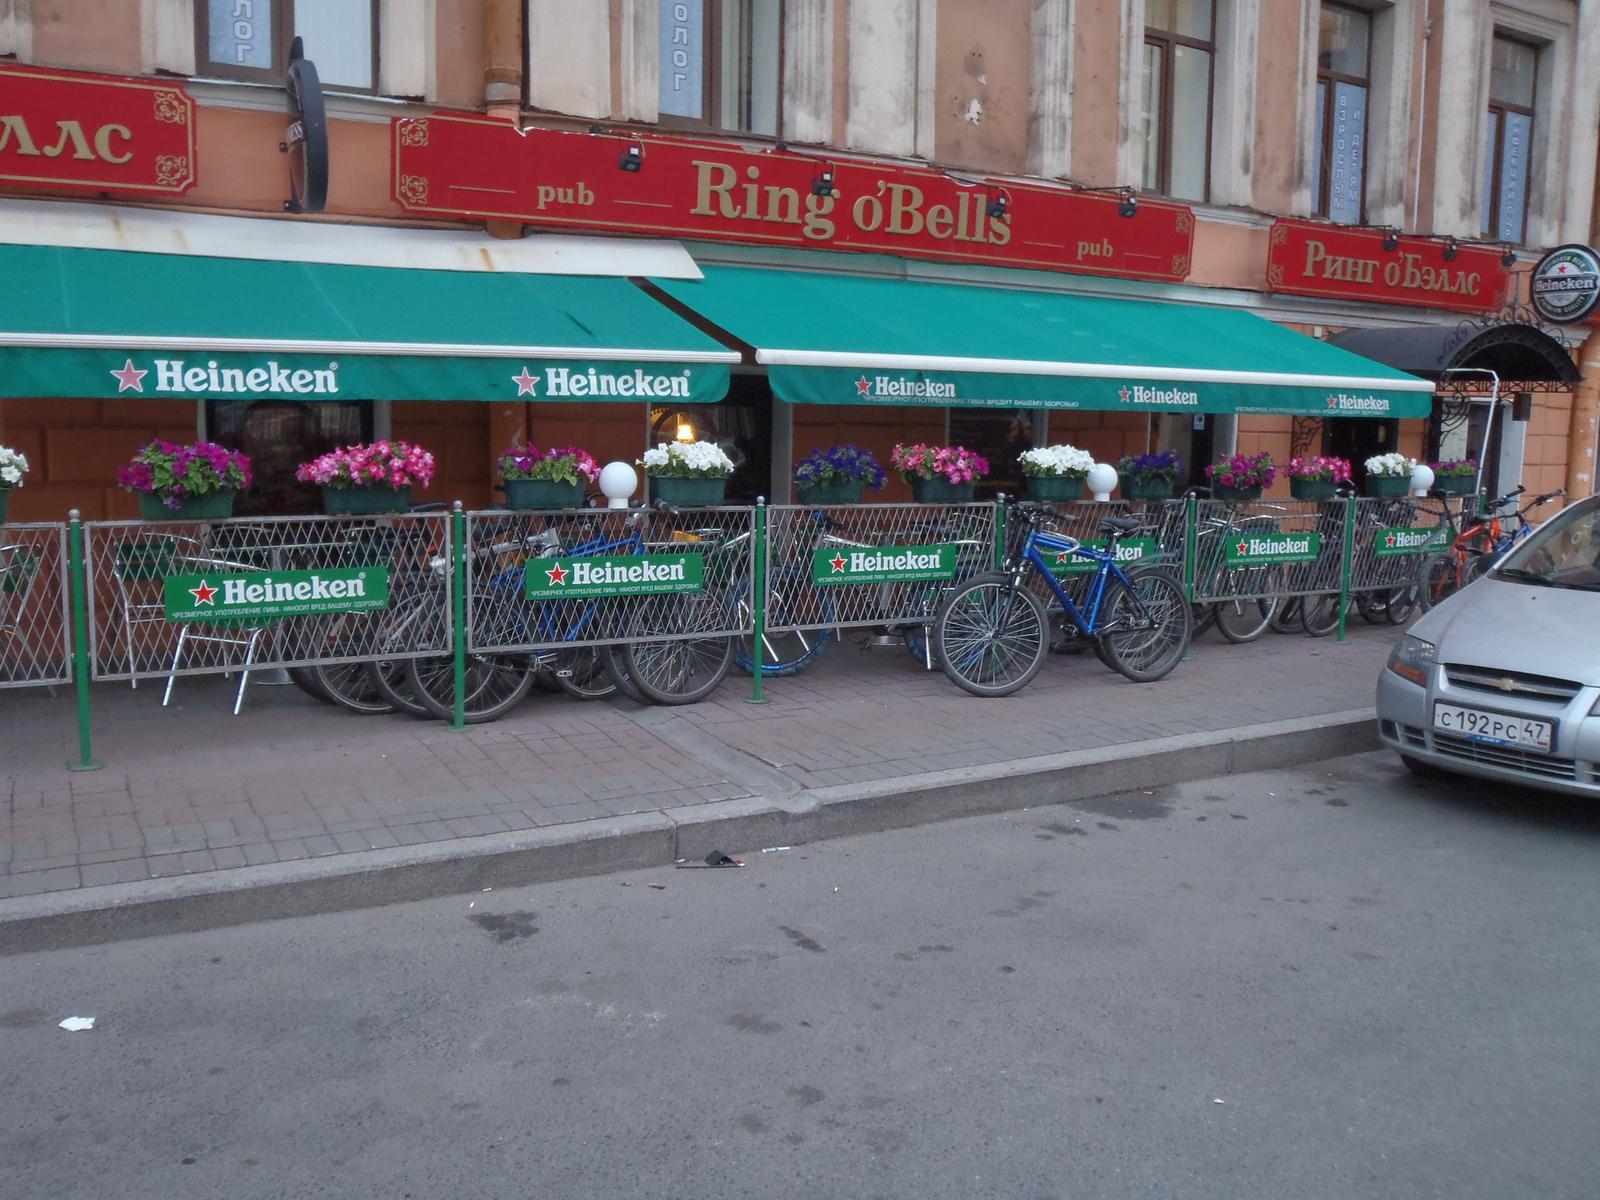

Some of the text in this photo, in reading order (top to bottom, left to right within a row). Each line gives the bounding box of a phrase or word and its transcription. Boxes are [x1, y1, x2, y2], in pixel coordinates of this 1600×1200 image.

[537, 182, 595, 209] pub
[690, 160, 841, 240] Ring
[1077, 239, 1114, 260] pub
[1536, 278, 1594, 292] Heineken
[154, 360, 338, 393] Heineken
[545, 368, 690, 397] Heineken
[875, 376, 956, 397] Heineken
[1133, 386, 1198, 405] Heineken
[1339, 394, 1390, 410] Heineken
[1249, 538, 1309, 555] Heineken
[850, 551, 940, 572] Heineken
[572, 561, 685, 585] Heineken
[223, 576, 365, 605] Heineken
[172, 610, 213, 618] ЧРЕЗМЕРНОЕ
[214, 607, 261, 617] УПОТРЕБЛЕНИЕ
[262, 606, 280, 614] ПИВА
[283, 604, 310, 613] НАНОСИТ
[311, 603, 327, 611] ВРЕД
[327, 601, 352, 610] ВАШЕМУ
